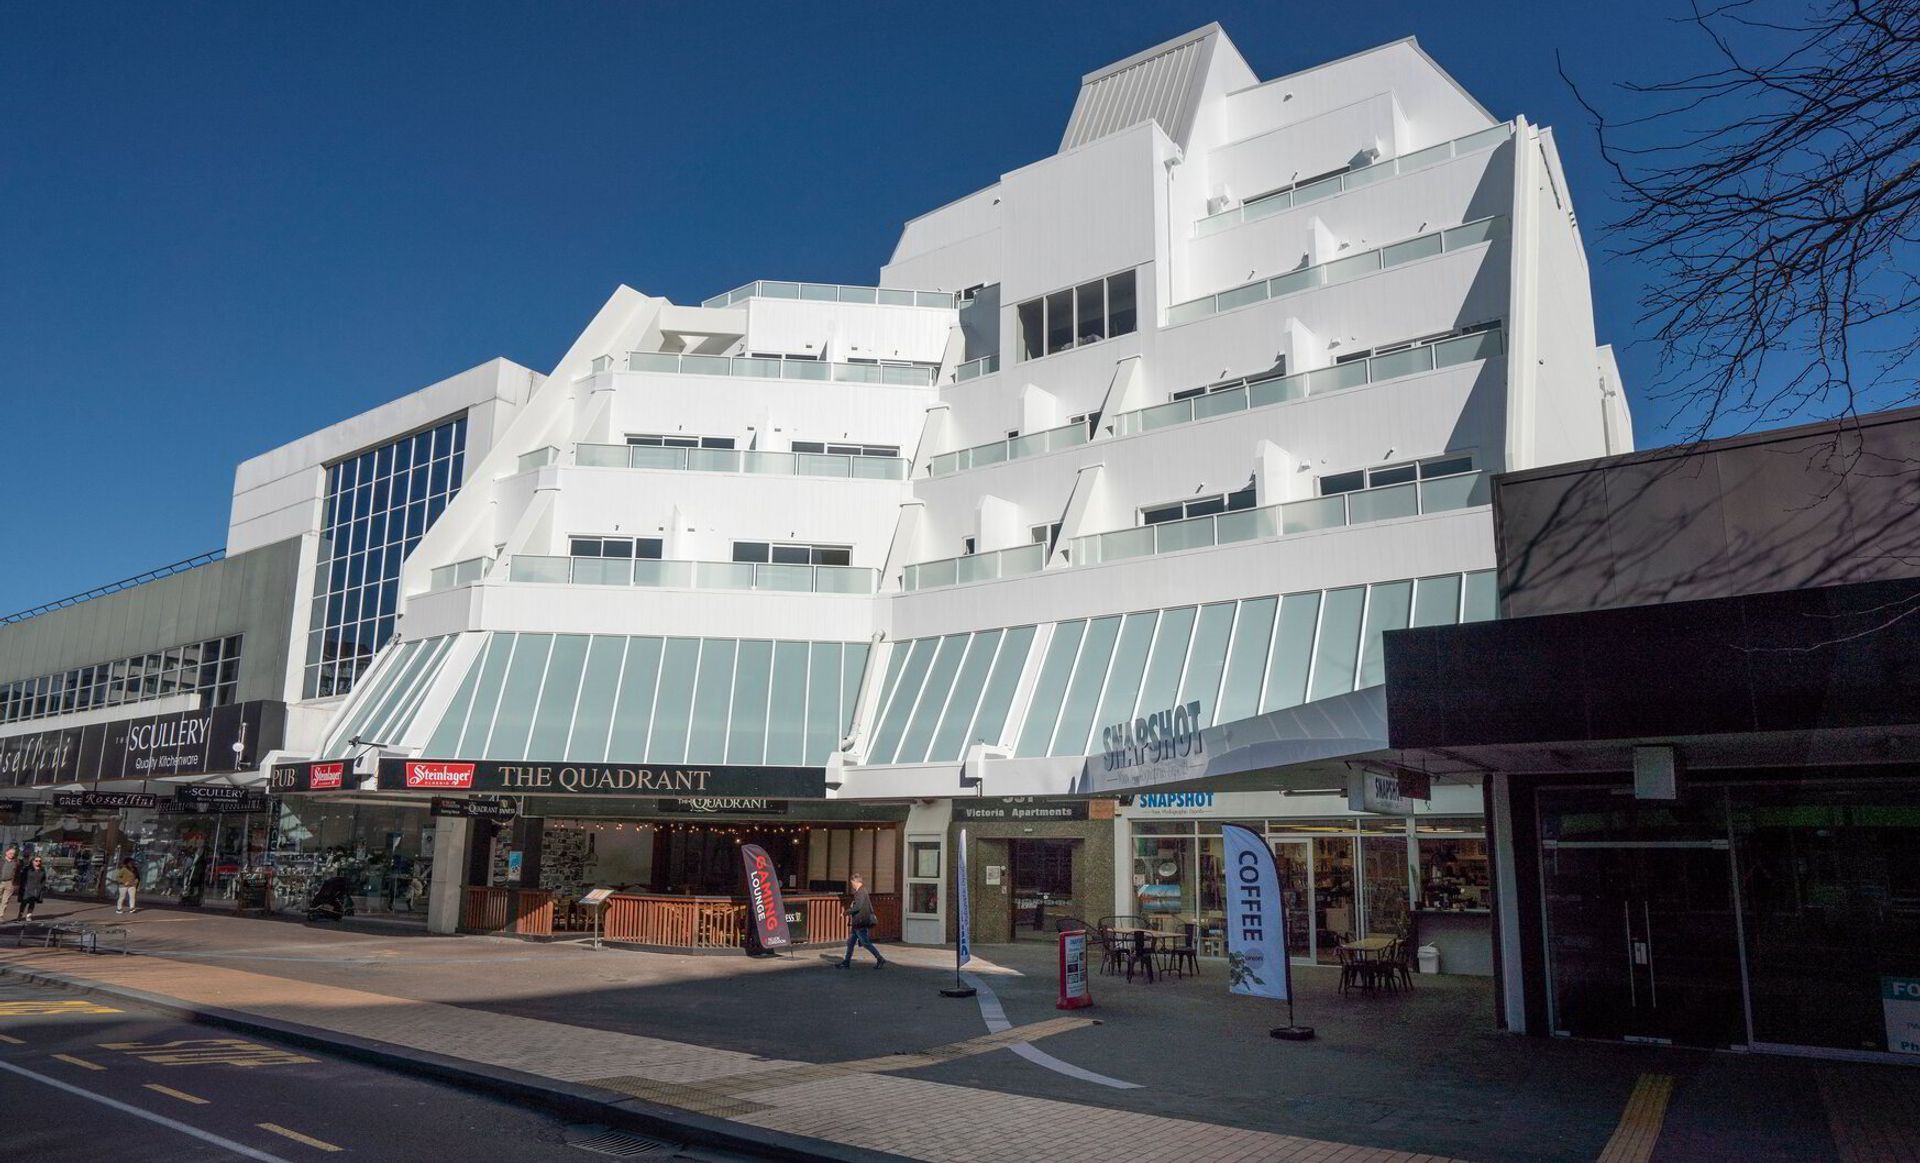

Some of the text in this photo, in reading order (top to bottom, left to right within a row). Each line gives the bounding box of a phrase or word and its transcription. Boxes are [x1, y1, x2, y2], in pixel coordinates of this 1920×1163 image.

[129, 717, 210, 751] SCULLERY
[1103, 700, 1203, 771] SNAPSHOT
[272, 768, 296, 787] PUB
[409, 765, 470, 786] Steinlager
[498, 766, 711, 792] THE QUADRANT
[191, 788, 245, 798] SCULLERY
[1140, 791, 1214, 808] SNAPSHOT
[692, 799, 768, 812] QUADRANT
[966, 807, 1072, 818] Victoria Apartments
[750, 871, 766, 921] LOUNGE
[756, 856, 778, 931] GAMING
[1238, 850, 1263, 941] COFFEE
